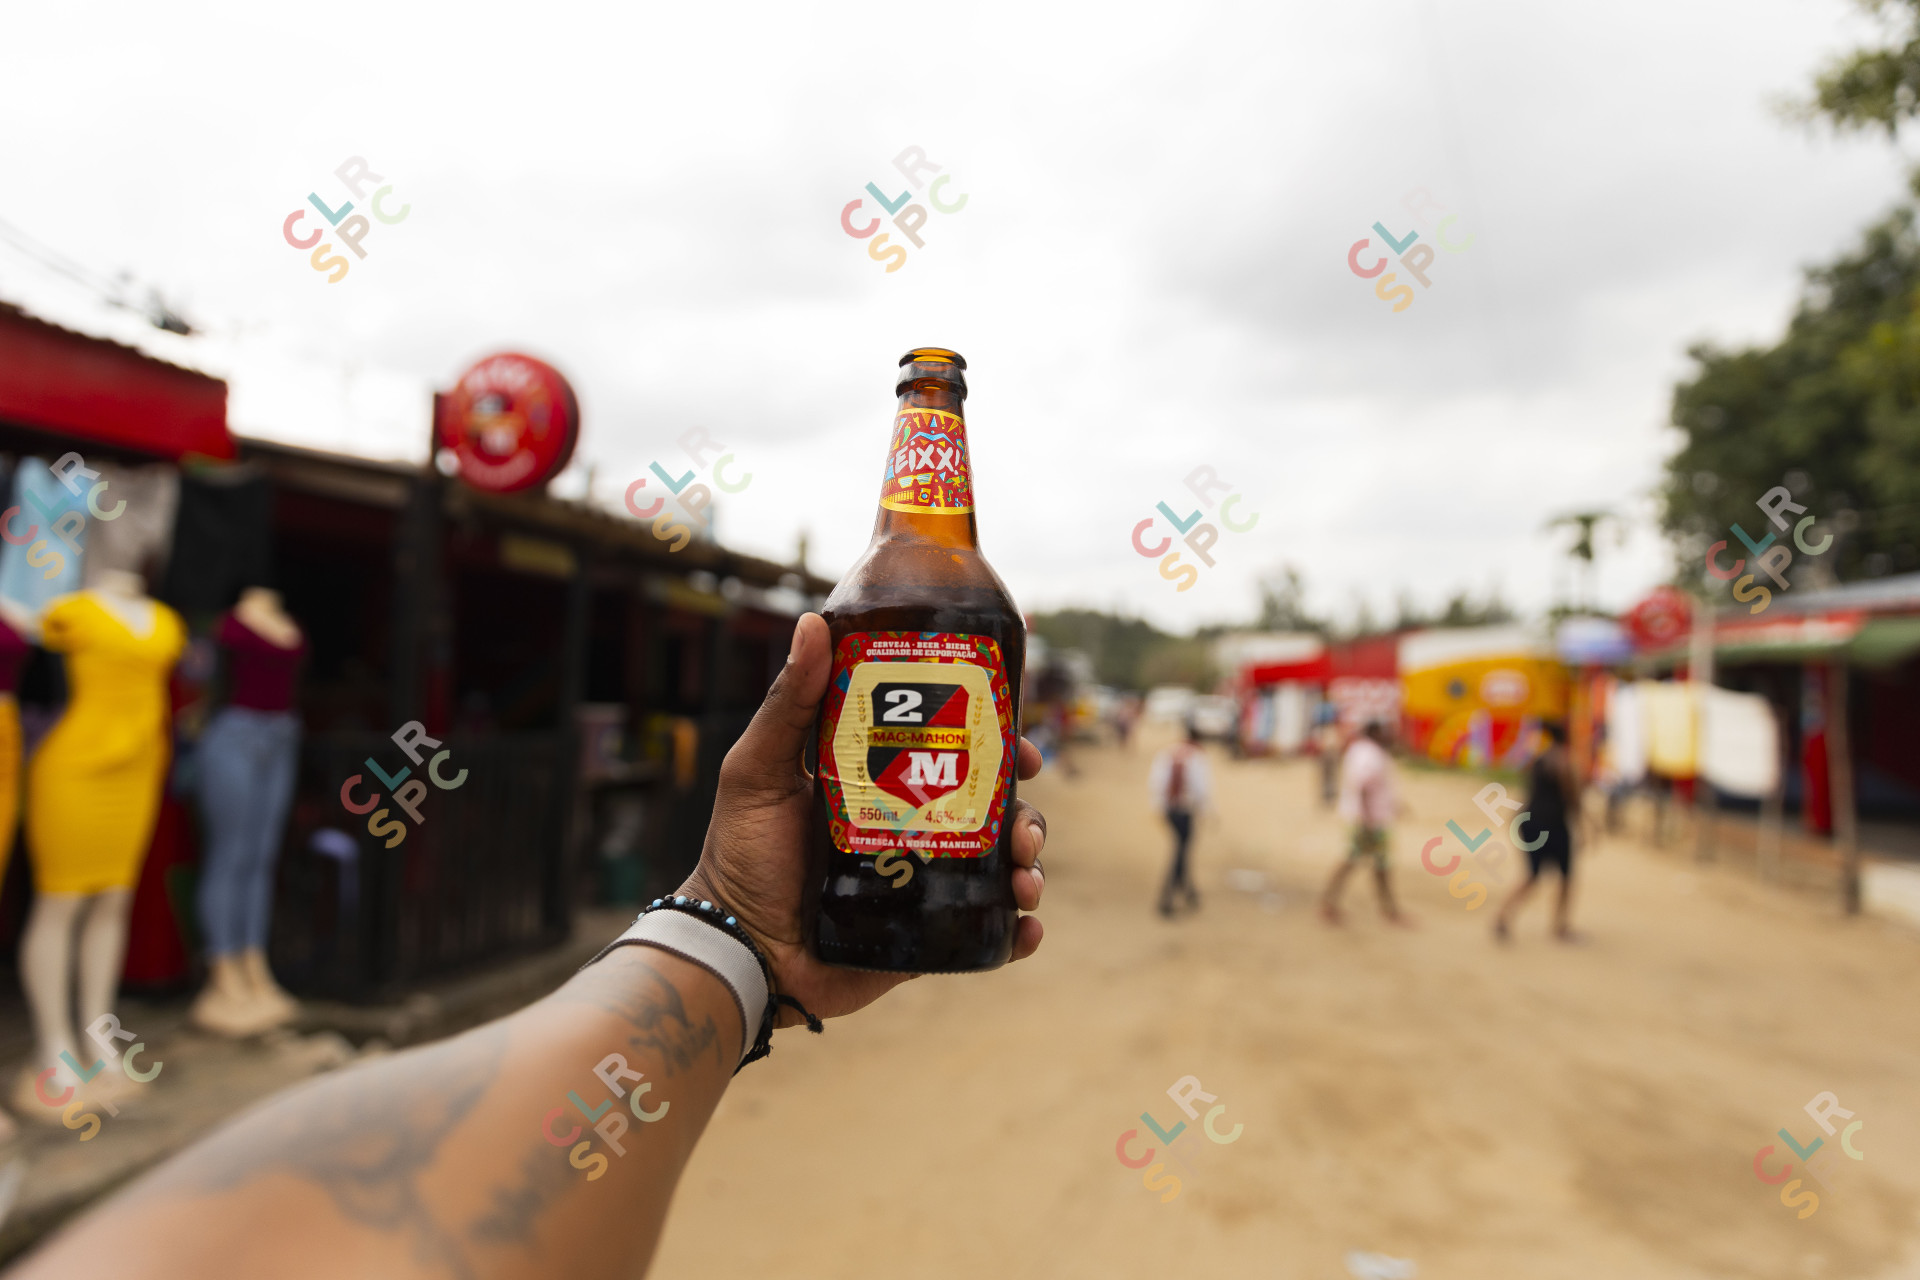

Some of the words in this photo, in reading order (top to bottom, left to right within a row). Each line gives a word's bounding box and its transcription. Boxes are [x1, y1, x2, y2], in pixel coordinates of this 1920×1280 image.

[872, 641, 910, 649] CERVEJA
[917, 641, 940, 649] BEER
[945, 643, 971, 651] BIERE
[866, 648, 911, 657] QUALIDADE
[924, 649, 977, 659] EXPORTAÇÃO
[883, 689, 923, 722] 2
[907, 752, 959, 786] M
[849, 836, 895, 847] REFRESCA
[906, 839, 938, 849] NOSSA
[940, 839, 982, 849] MANEIRA
